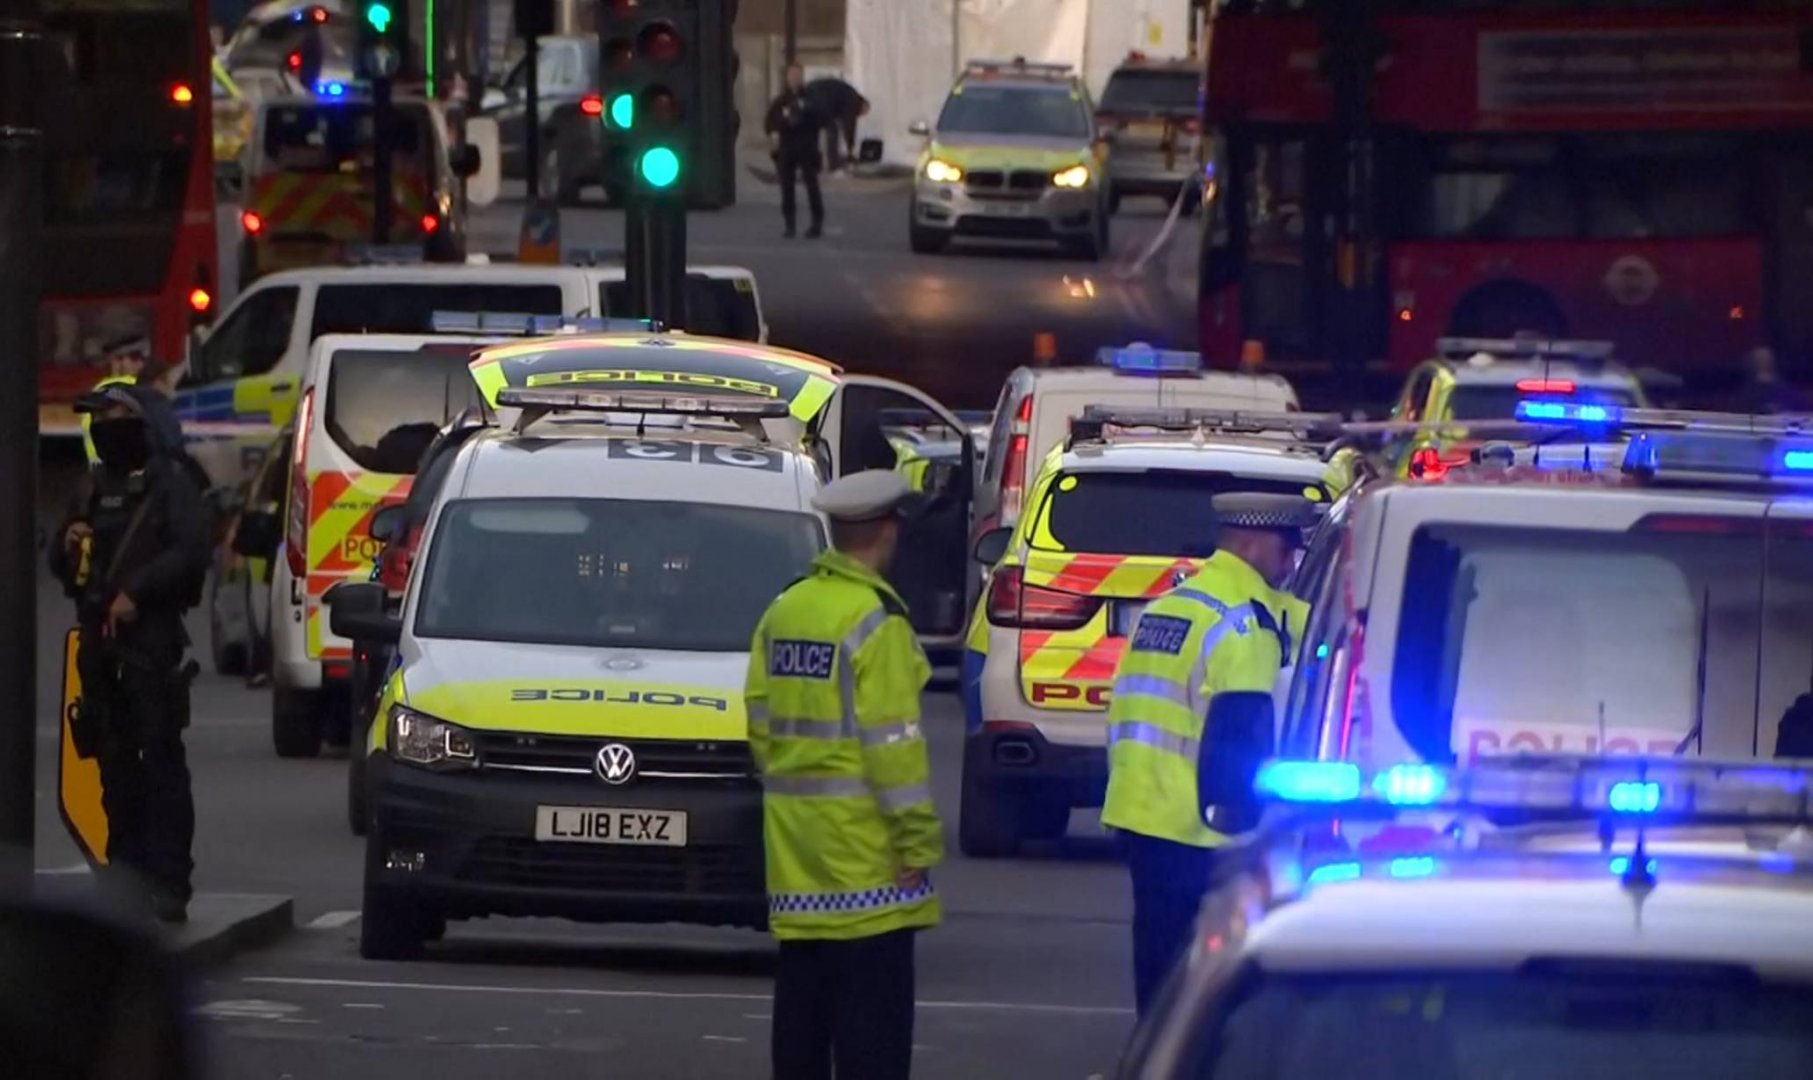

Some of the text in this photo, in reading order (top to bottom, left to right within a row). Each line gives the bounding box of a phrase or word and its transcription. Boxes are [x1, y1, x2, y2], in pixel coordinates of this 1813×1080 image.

[773, 643, 832, 675] POLICE
[552, 811, 670, 841] LJ18 EXZ
